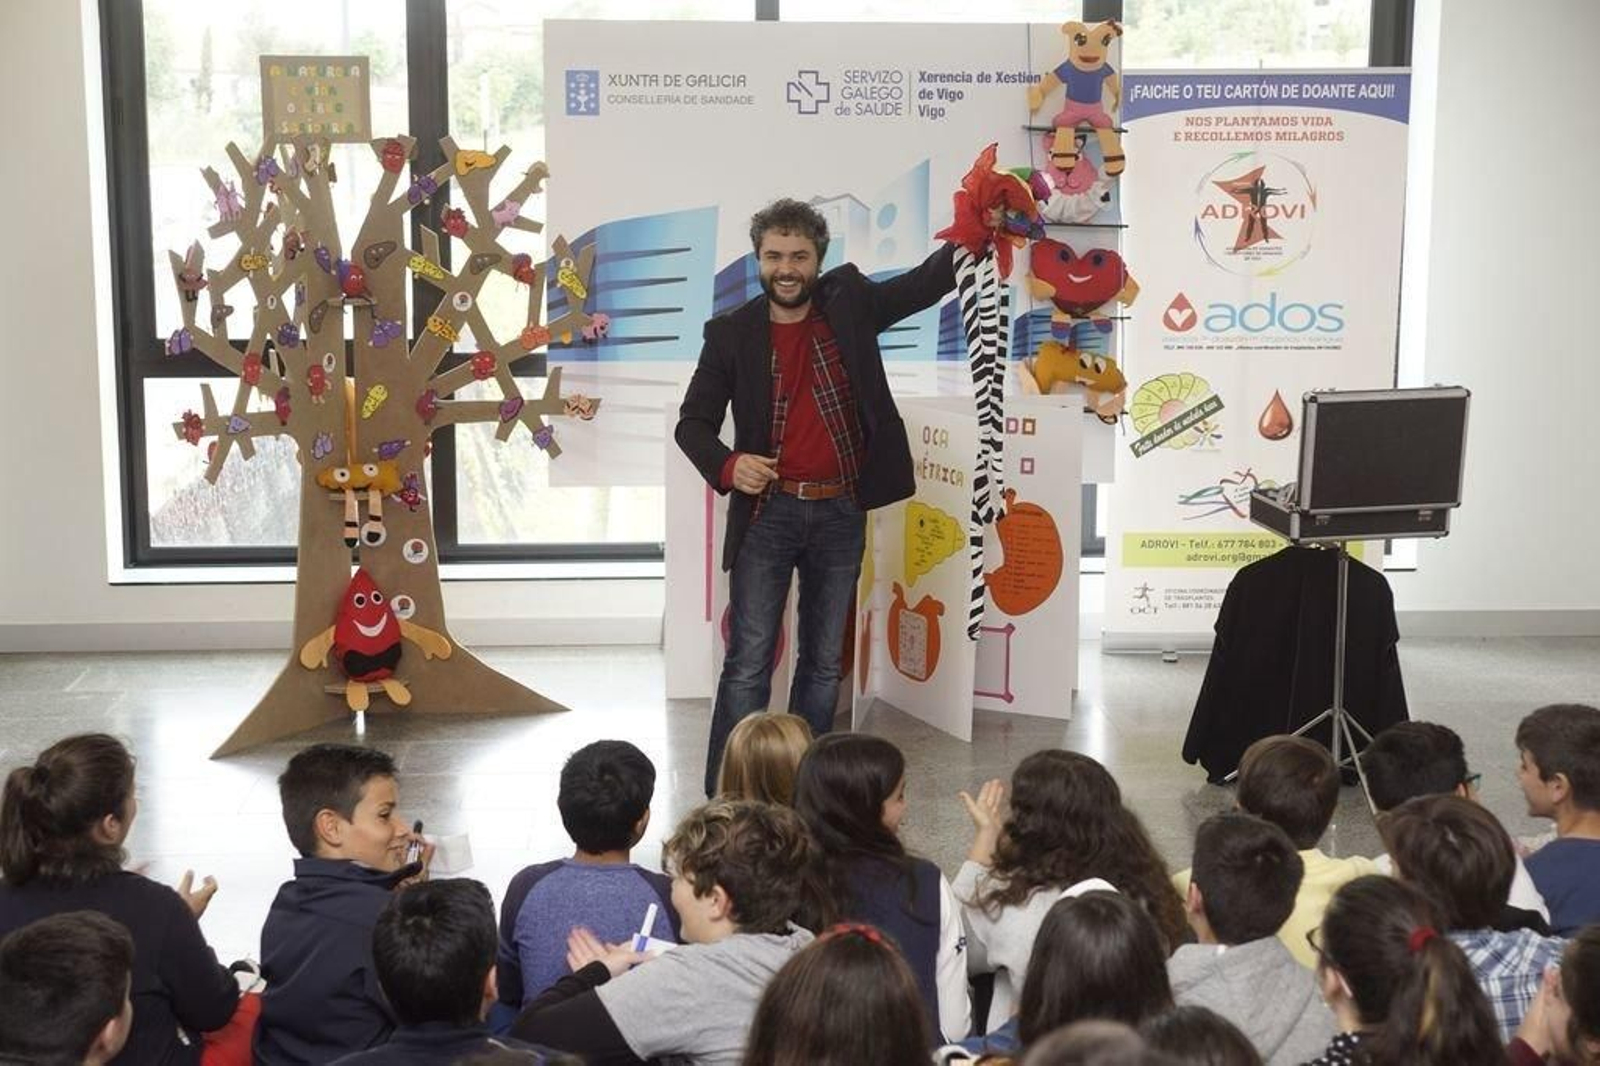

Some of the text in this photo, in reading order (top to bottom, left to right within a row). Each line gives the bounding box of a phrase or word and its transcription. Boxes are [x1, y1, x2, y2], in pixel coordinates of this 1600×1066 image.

[608, 74, 747, 88] XUNTA DE GALICIA
[844, 70, 903, 84] SERVIZO
[918, 71, 973, 83] Xerencia
[976, 71, 992, 83] de
[684, 94, 698, 105] DE
[700, 94, 755, 105] SANIDADE
[841, 86, 904, 100] GALEGO
[918, 88, 964, 103] de Vigo
[1130, 84, 1179, 103] ¡FAICHE
[1183, 85, 1194, 99] O
[1196, 84, 1221, 99] TEU
[1224, 82, 1277, 99] CARTÓN
[1281, 84, 1299, 98] DE
[1302, 84, 1356, 98] DOANTE
[834, 101, 851, 116] de
[918, 105, 946, 120] Vigo
[1185, 116, 1334, 127] NOS PLANTAMOS VIDA
[1174, 131, 1344, 142] E RECOLLEMOS MILAGROS
[1201, 204, 1306, 220] ADROVI
[1204, 292, 1345, 333] ados
[922, 425, 949, 449] OCA
[1140, 539, 1179, 549] ADROVI
[1216, 539, 1236, 549] 677
[1238, 539, 1256, 549] 784
